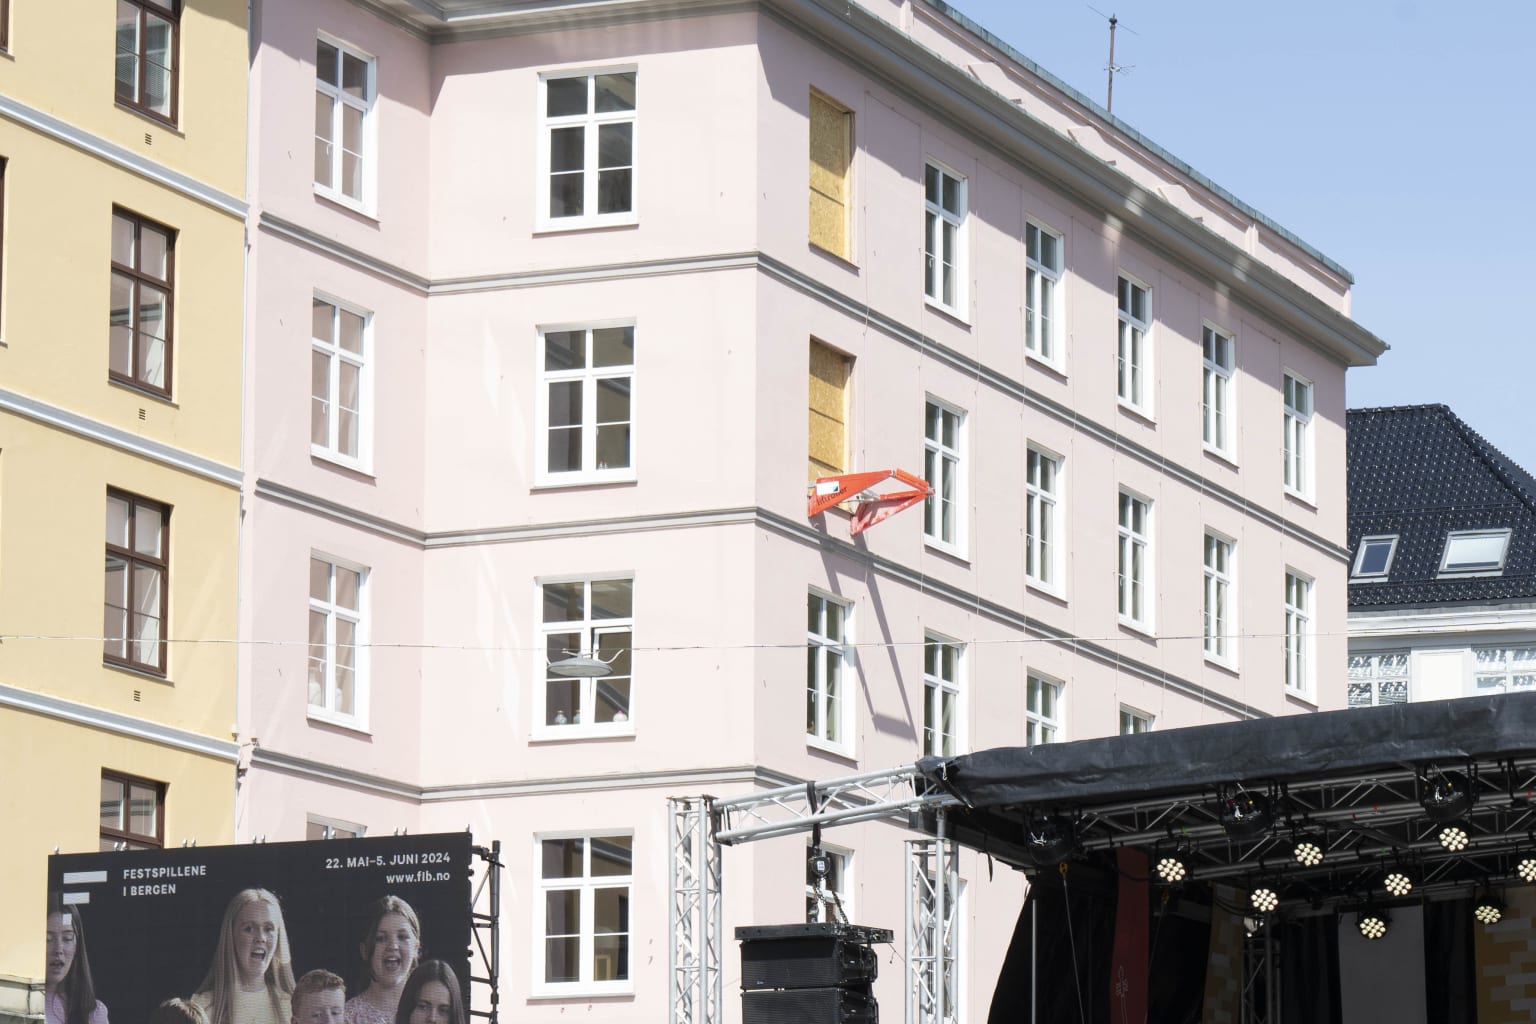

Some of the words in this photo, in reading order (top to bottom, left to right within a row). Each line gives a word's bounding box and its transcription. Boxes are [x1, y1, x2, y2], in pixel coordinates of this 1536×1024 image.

[326, 858, 343, 869] 22.
[390, 854, 418, 865] JUNI
[421, 852, 450, 864] 2024
[123, 866, 206, 879] FESTSPILLENE
[123, 886, 127, 896] I
[131, 884, 176, 896] BERGEN
